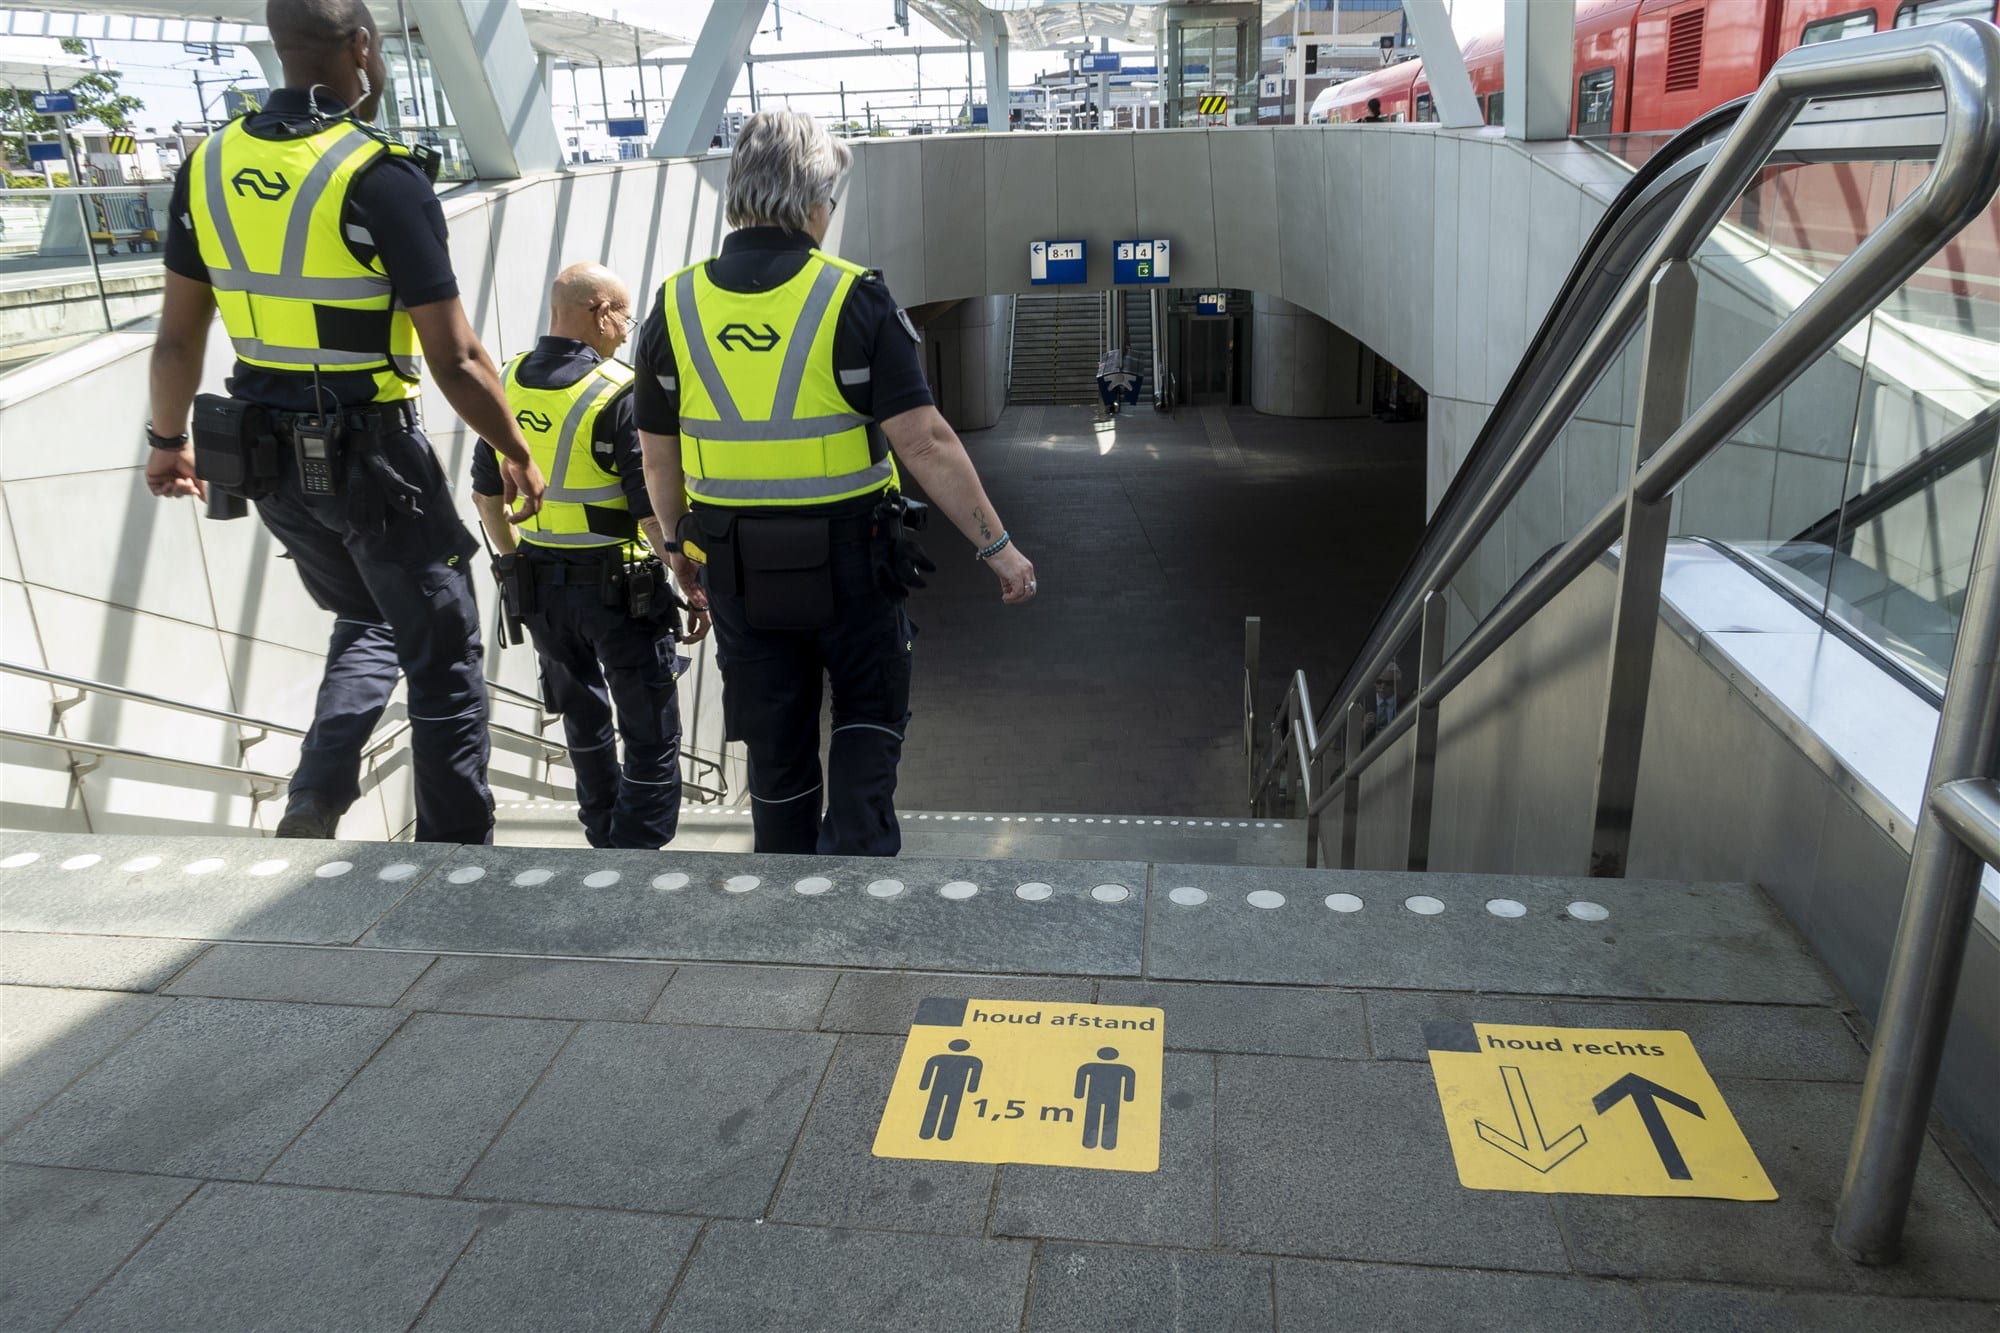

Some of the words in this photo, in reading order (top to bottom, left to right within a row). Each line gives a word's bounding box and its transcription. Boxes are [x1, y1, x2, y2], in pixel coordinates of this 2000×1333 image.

[1122, 248, 1129, 258] 3
[1140, 248, 1147, 258] 4
[972, 1009, 1042, 1025] houd
[1050, 1012, 1156, 1031] afstand
[1488, 1035, 1564, 1053] houd
[1572, 1039, 1666, 1057] rechts
[972, 1098, 1026, 1122] 1,5
[1039, 1105, 1075, 1123] m
